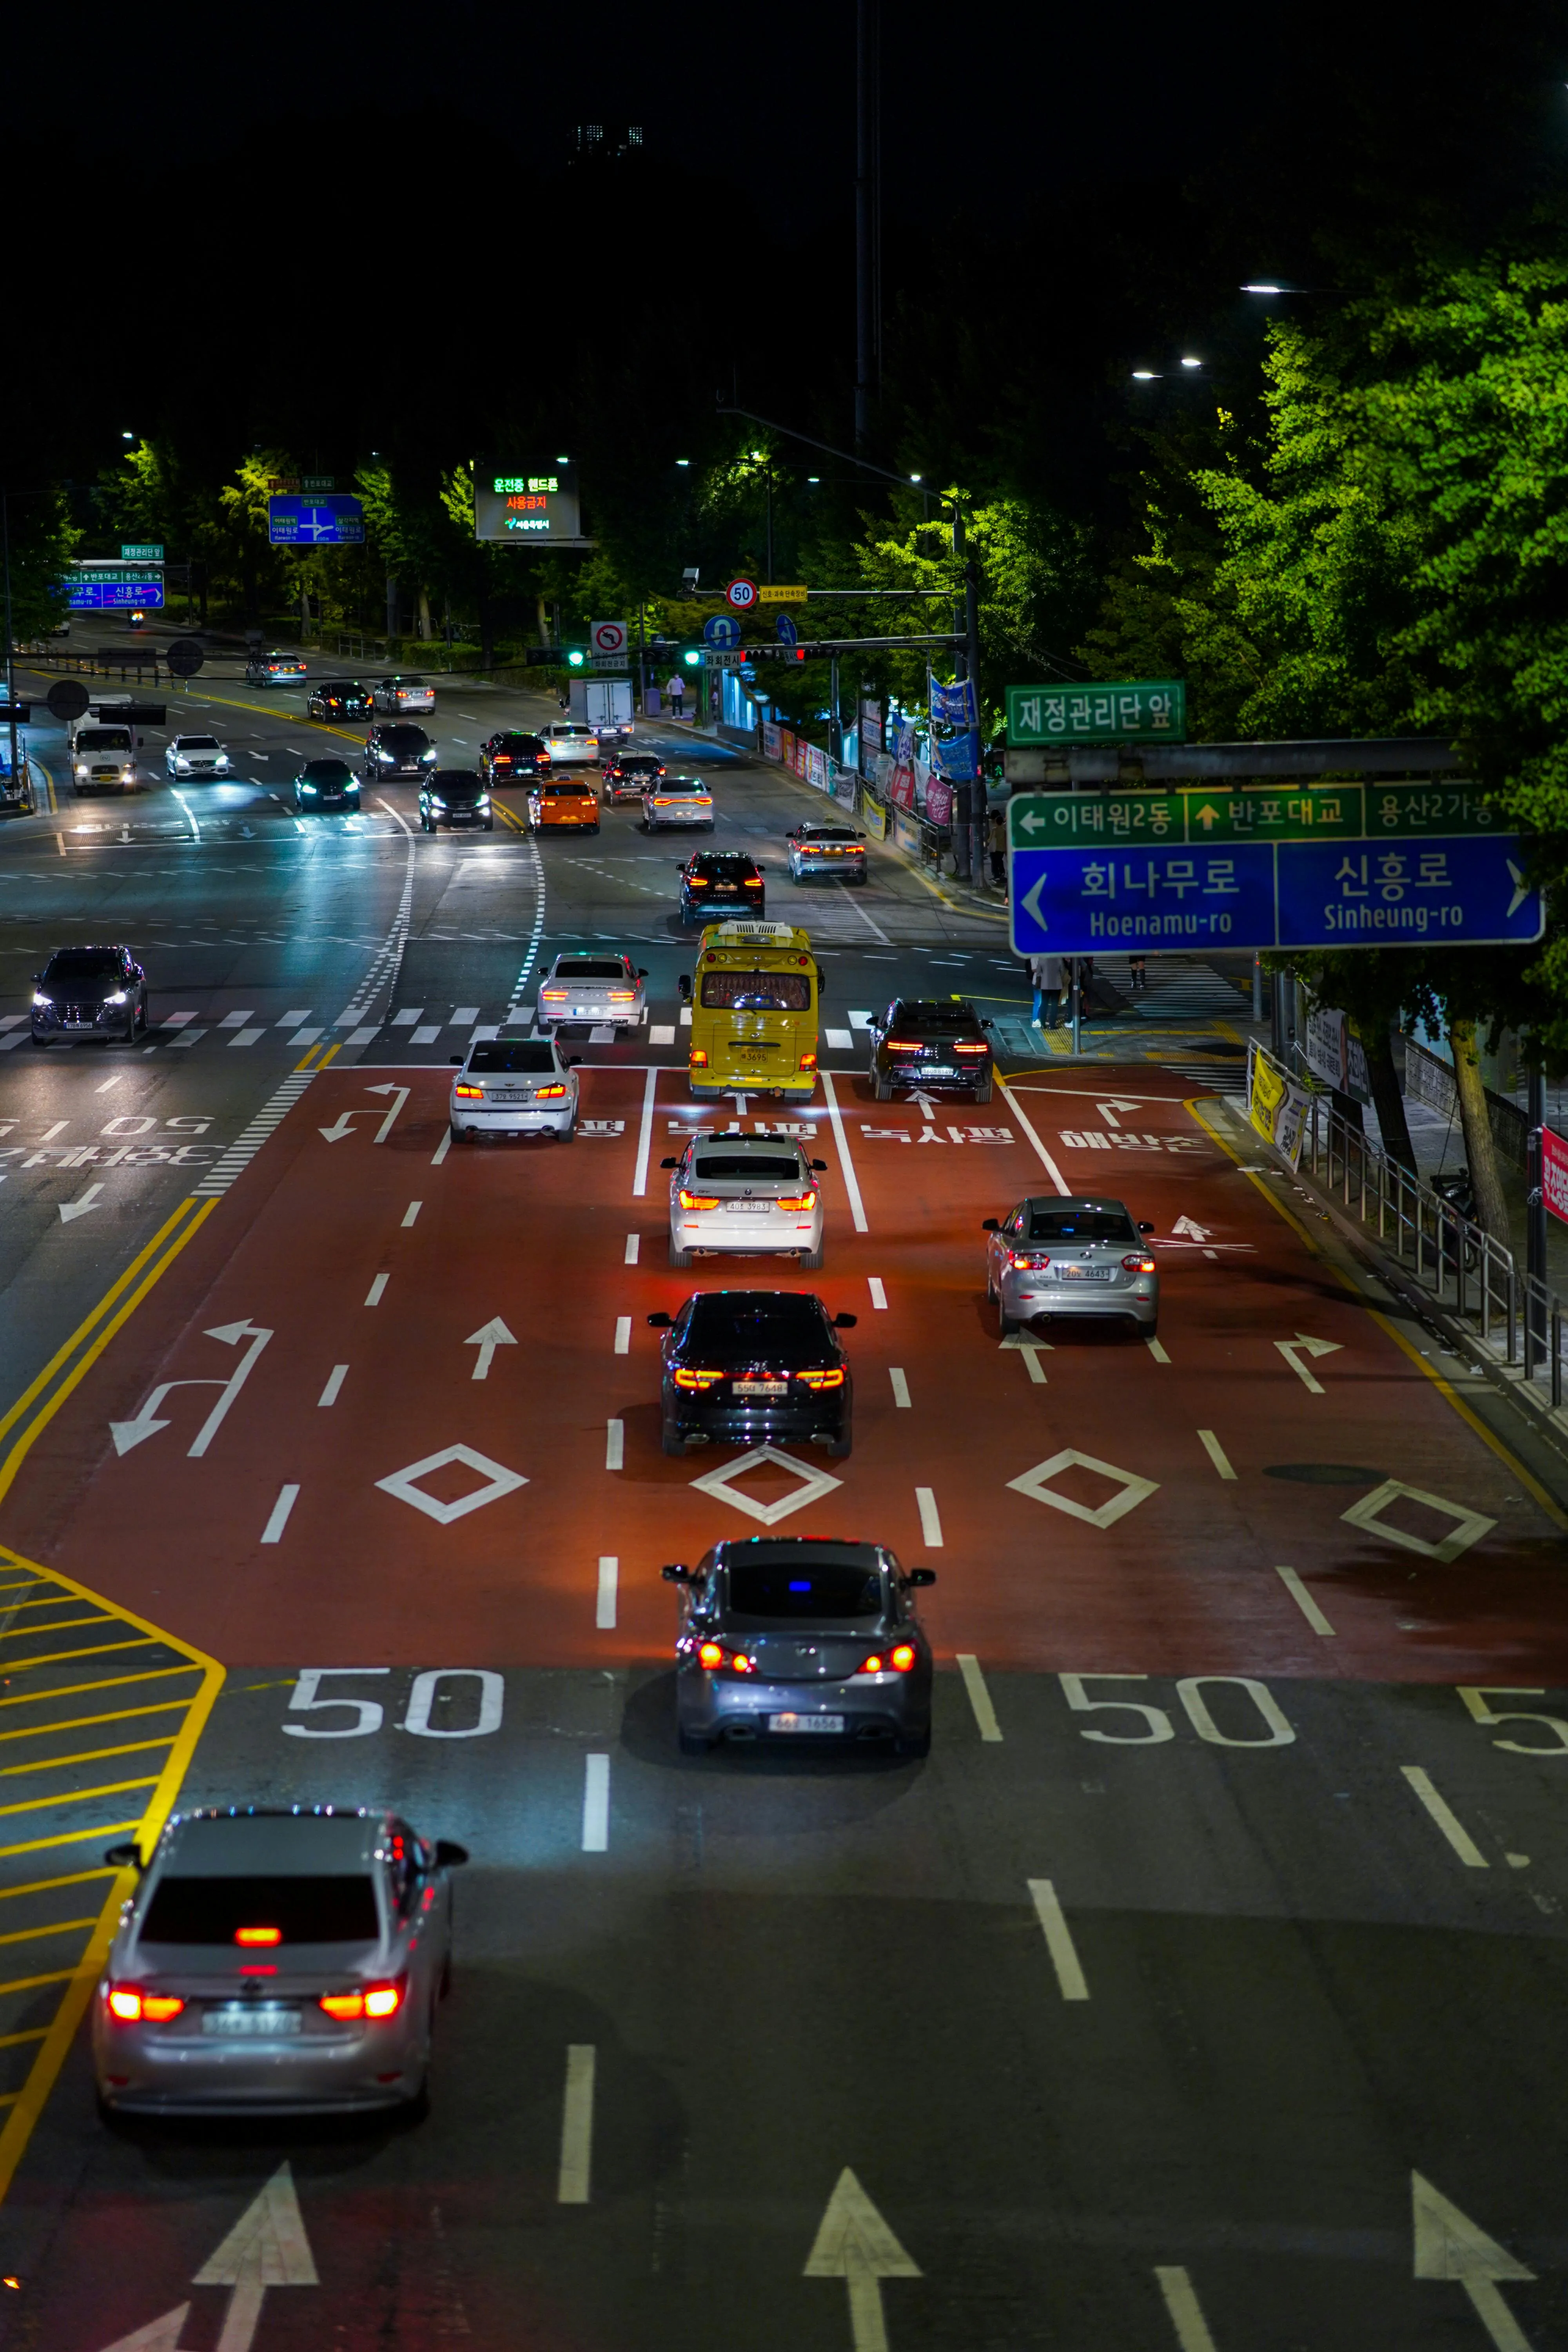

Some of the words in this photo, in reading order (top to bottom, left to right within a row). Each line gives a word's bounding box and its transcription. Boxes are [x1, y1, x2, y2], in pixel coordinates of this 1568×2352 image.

[494, 478, 524, 492] 운전중
[507, 496, 546, 510] 사용금지
[125, 548, 152, 556] 재정관리단
[154, 548, 160, 557] 앞
[116, 586, 143, 598] 신흥로
[734, 587, 750, 601] 50
[706, 655, 739, 666] 좌회전시
[1019, 693, 1142, 733] 재정관리단
[1149, 692, 1172, 729] 앞
[1054, 802, 1172, 836] 이태원2동
[1228, 797, 1343, 832] 반포대교
[1081, 860, 1240, 901] 회나무로
[1334, 852, 1452, 901] 신흥로
[1090, 912, 1232, 937] Hoenamu-ro
[1324, 904, 1463, 932] Sinheung-ro
[99, 1116, 216, 1135] 50
[860, 1125, 1016, 1144] 녹사평
[1057, 1131, 1213, 1154] 해방촌
[281, 1667, 505, 1738] 50
[1058, 1672, 1296, 1747] 50
